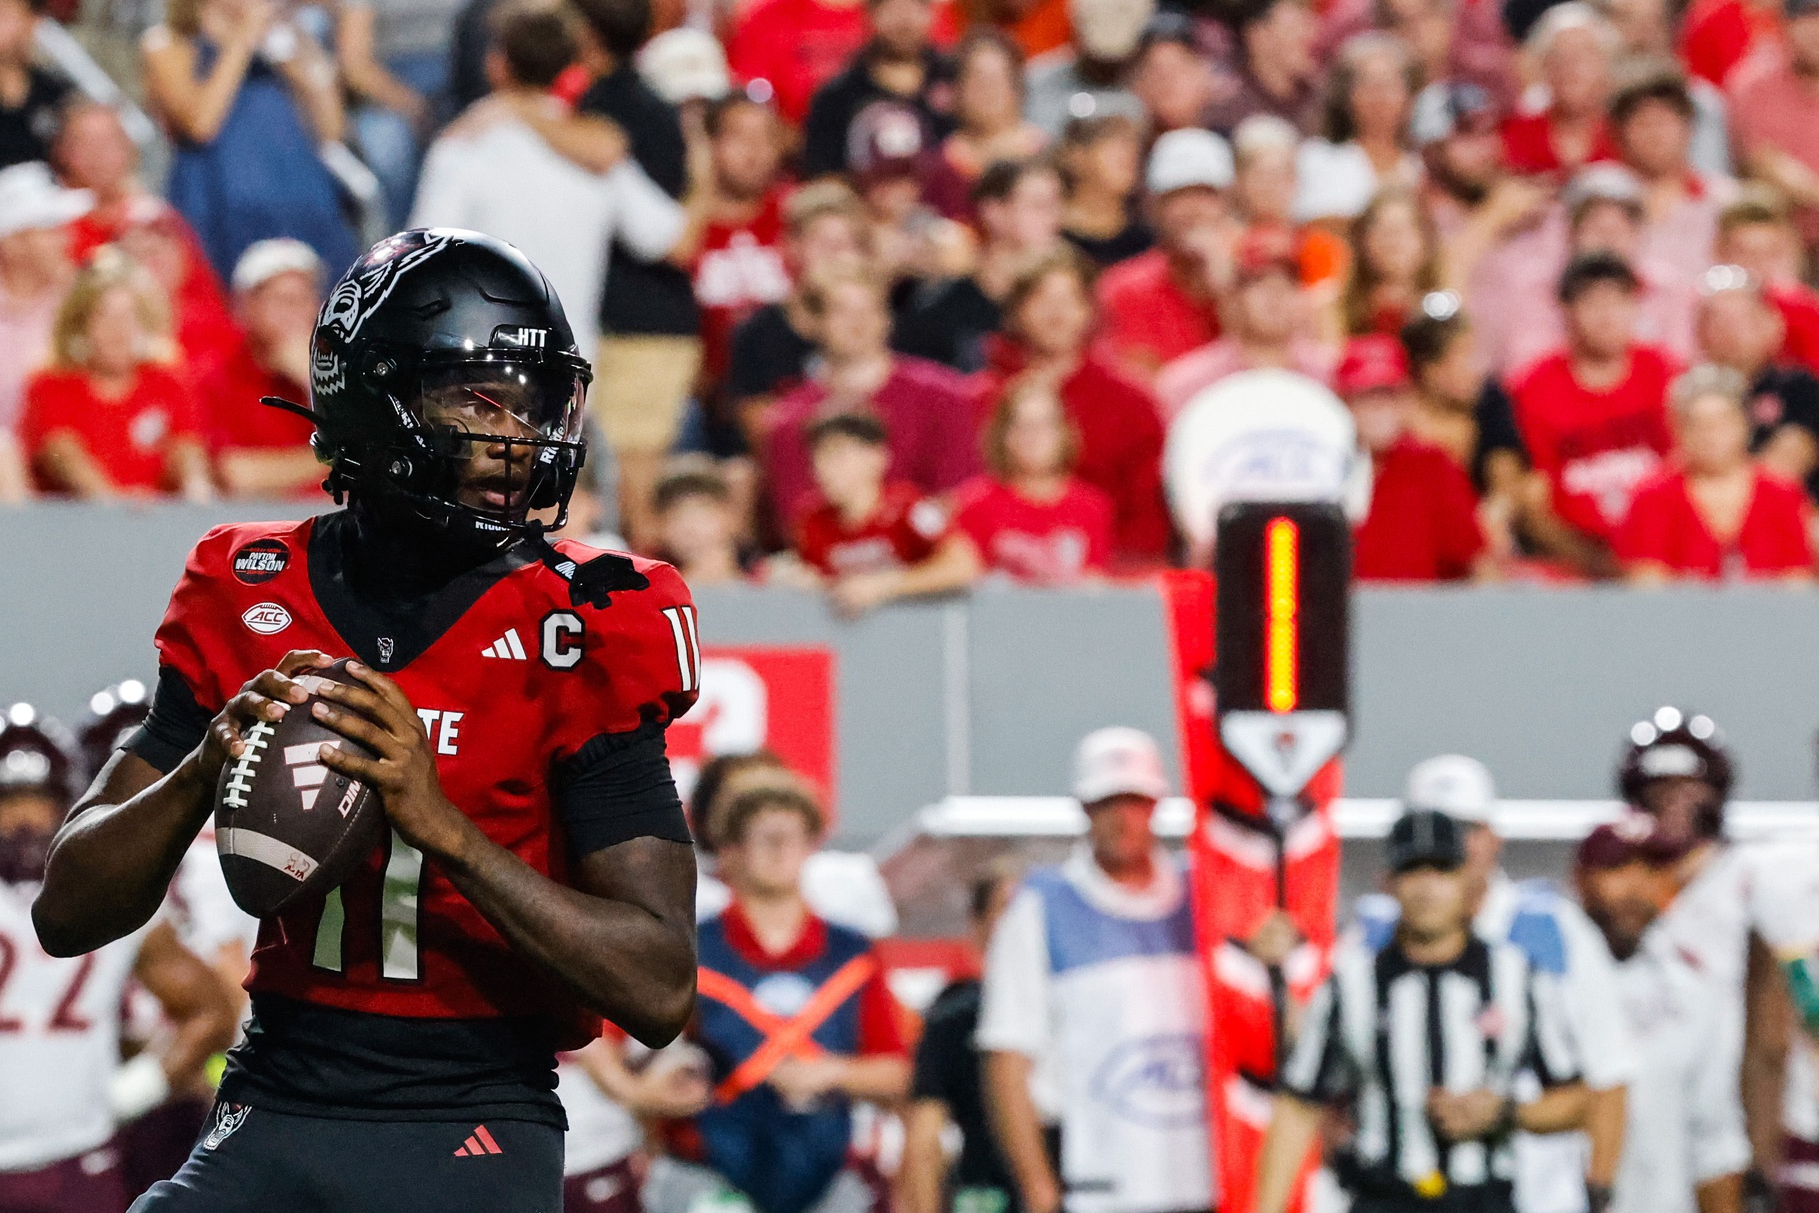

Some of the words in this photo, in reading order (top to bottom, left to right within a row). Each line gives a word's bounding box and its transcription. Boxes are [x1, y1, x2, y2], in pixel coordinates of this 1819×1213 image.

[517, 327, 548, 348] HTT
[249, 551, 277, 561] PAYTON
[234, 558, 285, 572] WILSON
[250, 611, 284, 623] ACC
[539, 609, 585, 672] C
[661, 605, 702, 692] 11
